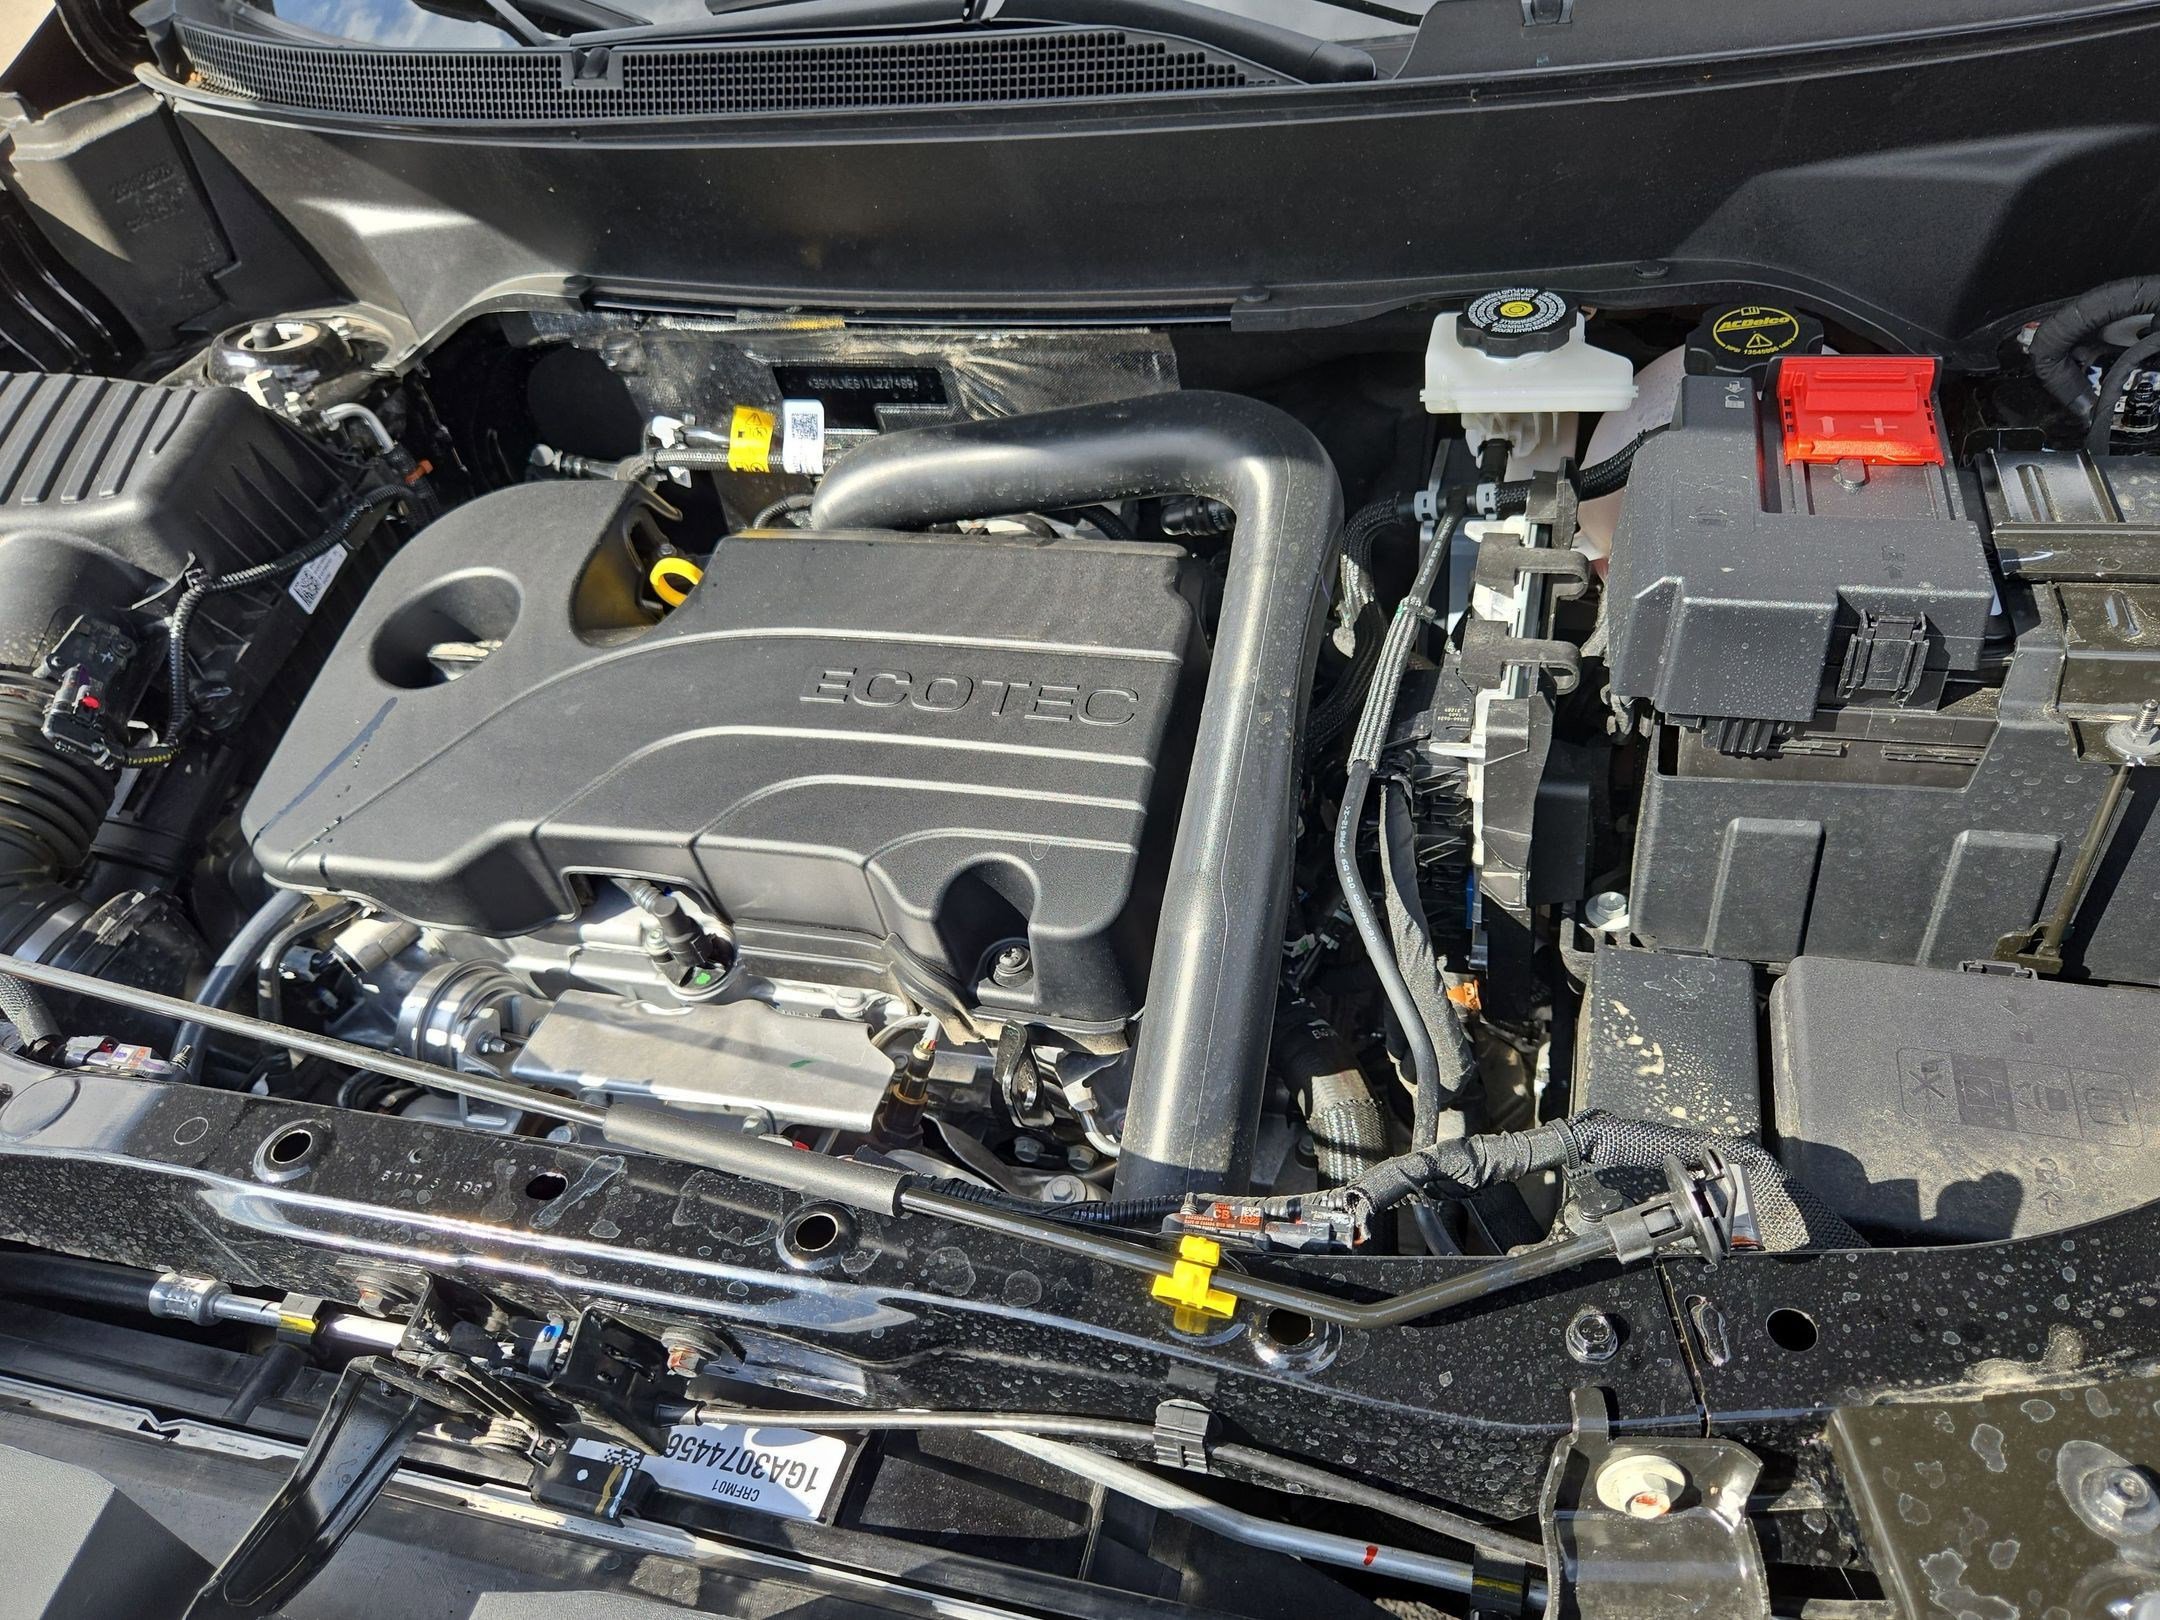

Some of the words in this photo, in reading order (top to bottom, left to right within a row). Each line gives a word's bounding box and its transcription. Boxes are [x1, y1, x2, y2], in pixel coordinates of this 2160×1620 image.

[800, 667, 1139, 726] ECOTEC
[663, 1433, 819, 1493] 1GA3074456
[712, 1478, 761, 1502] CRFM01
